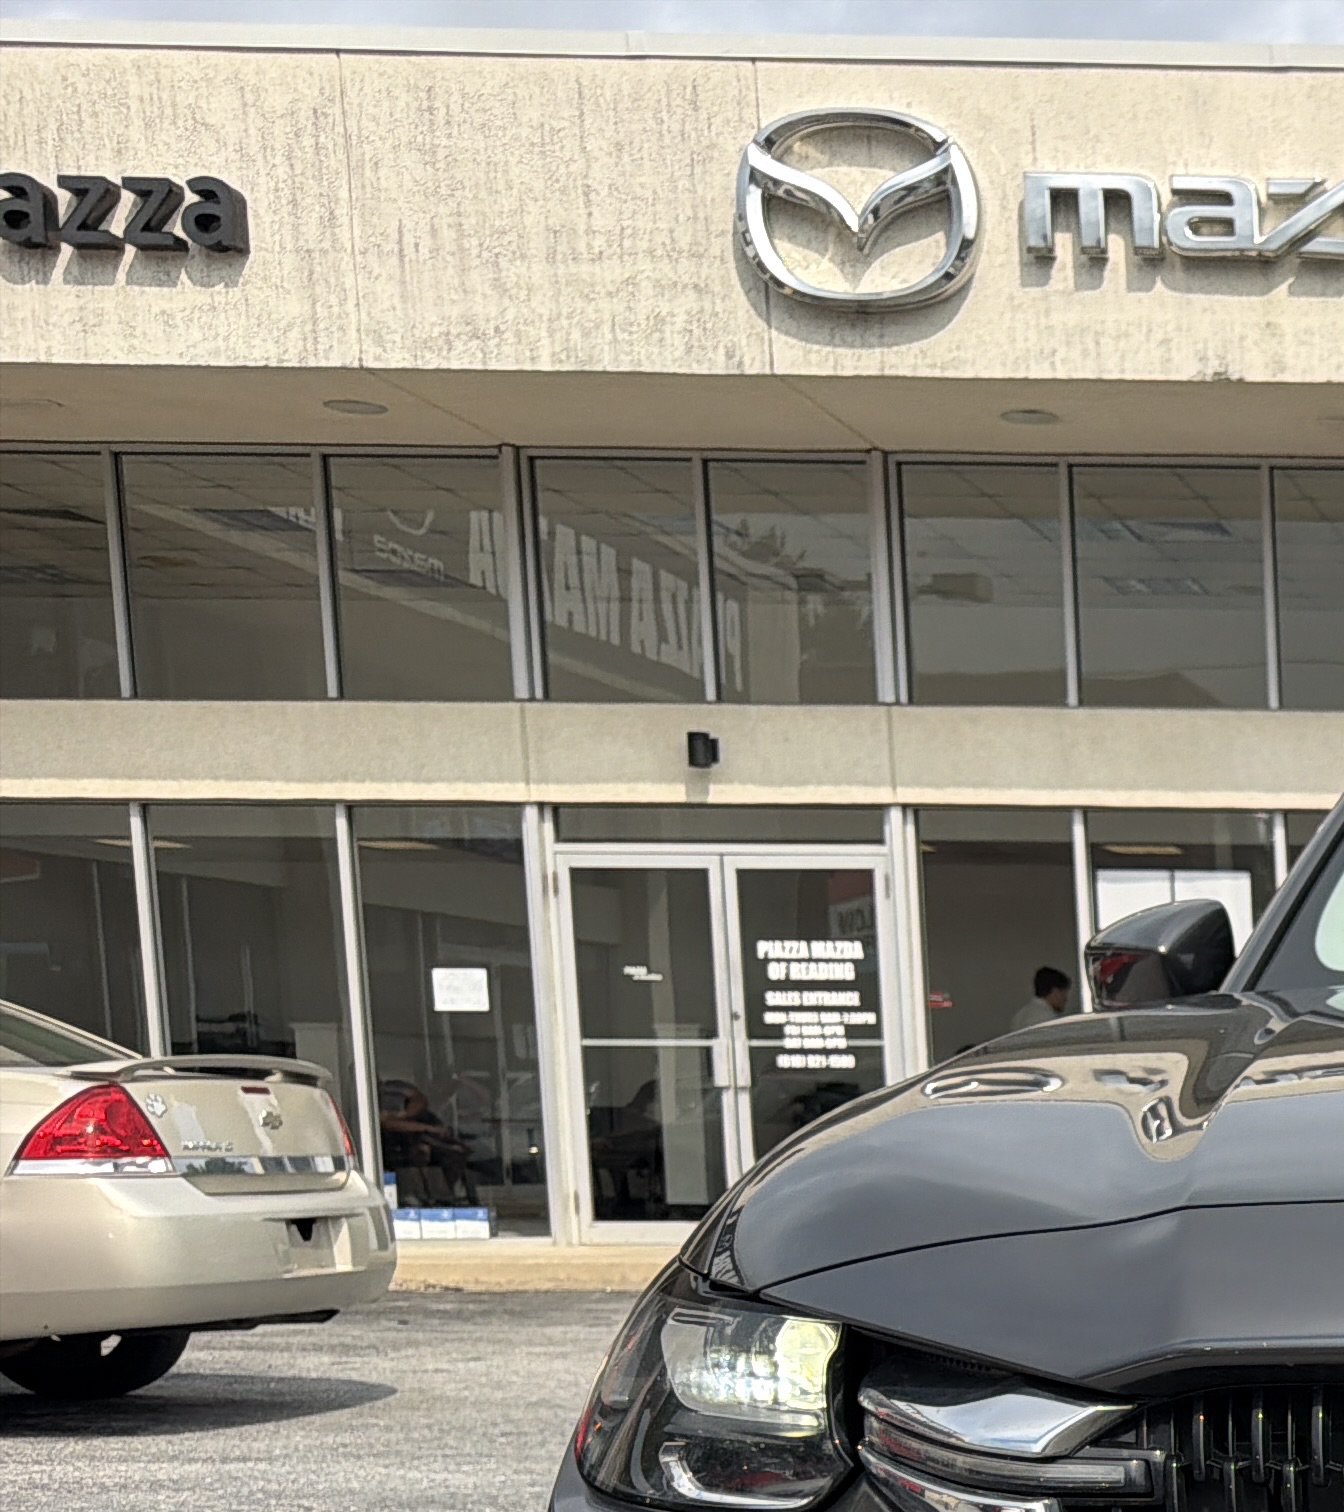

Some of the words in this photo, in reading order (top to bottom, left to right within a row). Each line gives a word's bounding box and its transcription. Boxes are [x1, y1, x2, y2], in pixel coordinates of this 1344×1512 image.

[756, 939, 810, 960] PIAZZA
[810, 939, 864, 960] MAZDA
[767, 961, 788, 980] OF
[789, 961, 856, 980] READING
[764, 990, 801, 1007] SALES
[802, 990, 861, 1007] ENTRANCE
